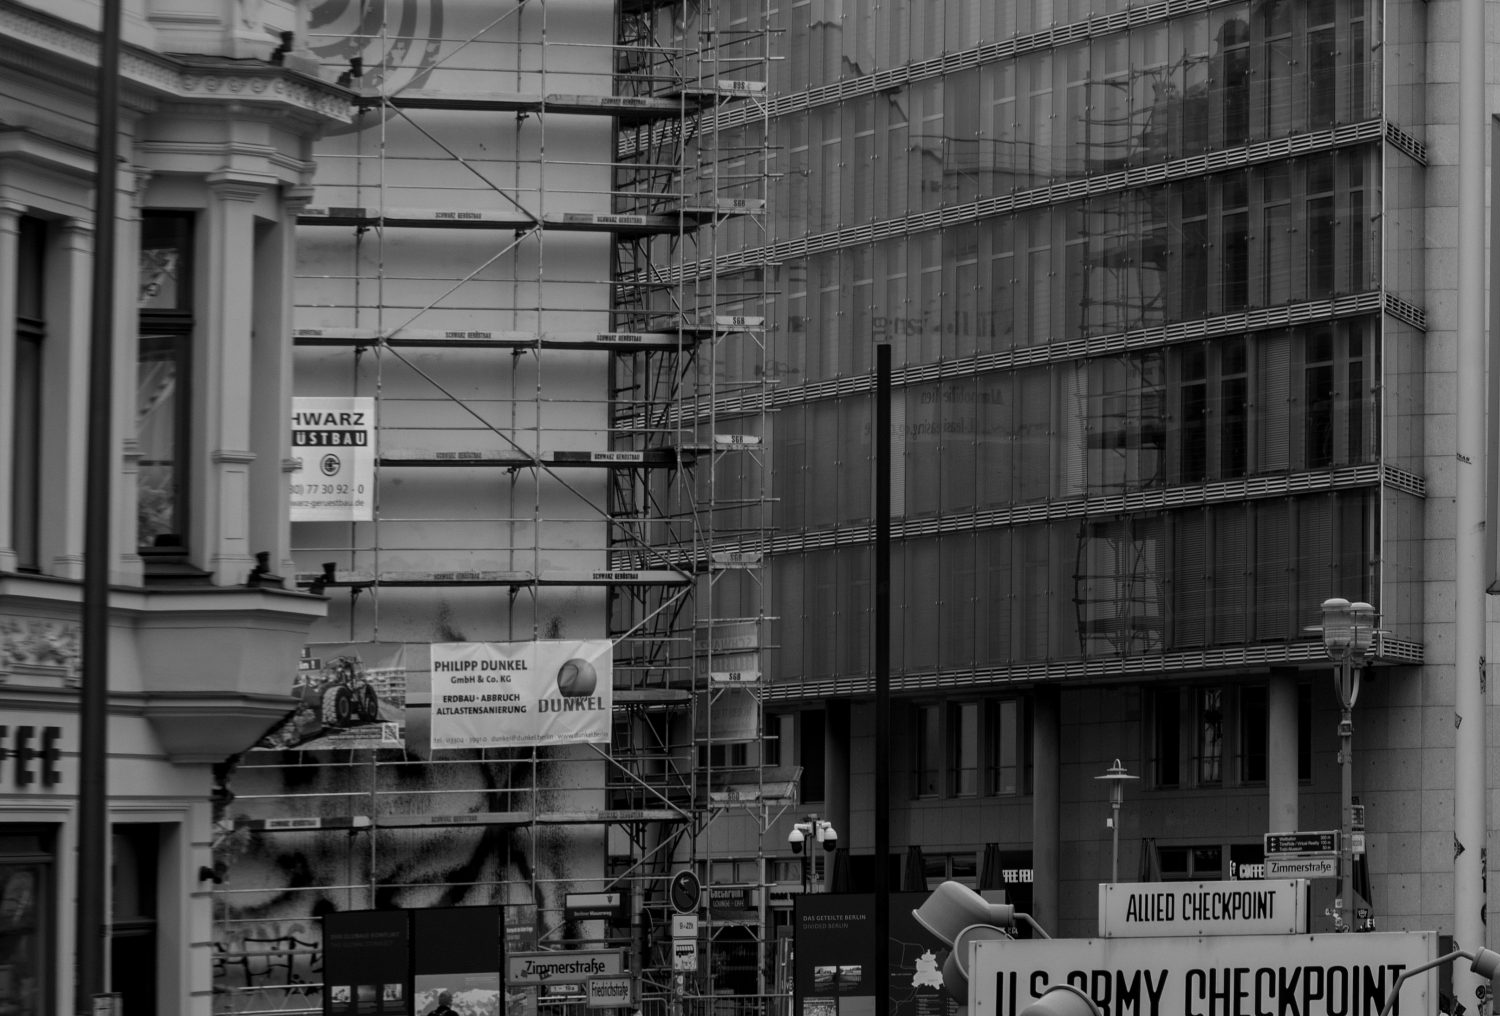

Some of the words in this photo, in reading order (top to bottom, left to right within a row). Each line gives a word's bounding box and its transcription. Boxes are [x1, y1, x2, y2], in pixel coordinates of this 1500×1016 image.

[306, 484, 319, 495] 77
[321, 484, 334, 495] 30
[336, 484, 349, 495] 92
[357, 484, 365, 495] 0
[434, 660, 478, 672] PHILIPP
[481, 660, 527, 671] DUNKEL
[450, 675, 475, 684] GmbH
[477, 675, 484, 683] &
[486, 675, 499, 683] Co.
[500, 674, 511, 683] KG
[443, 694, 475, 703] ERDBAU
[481, 693, 520, 702] ABBRUCH
[436, 705, 527, 716] ALTLASTENSANIERUNG
[538, 696, 606, 713] DUNKEL
[1271, 861, 1332, 874] Zimmerstraße
[1126, 893, 1175, 922] ALLIED
[1182, 891, 1276, 921] CHECKPOINT
[803, 922, 827, 930] DIVIDED
[525, 958, 606, 975] Zimmerstraße
[591, 981, 629, 1000] Friedrichstraße
